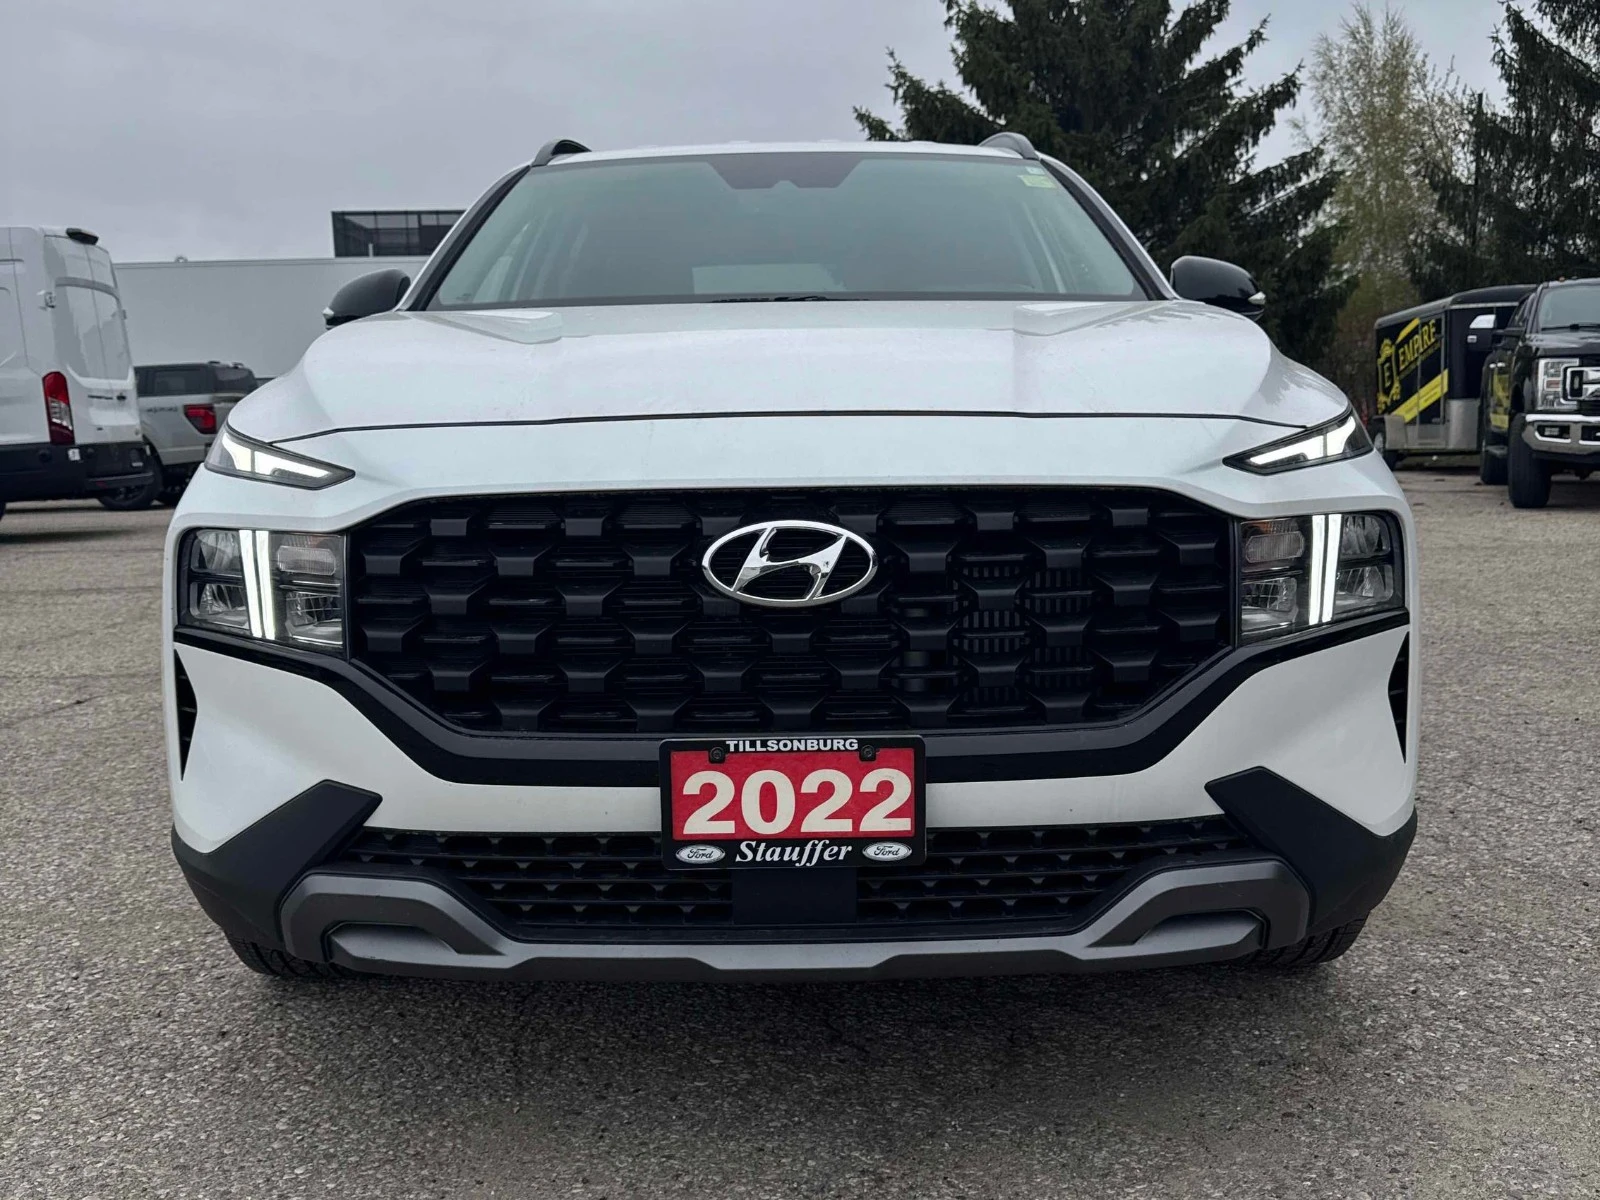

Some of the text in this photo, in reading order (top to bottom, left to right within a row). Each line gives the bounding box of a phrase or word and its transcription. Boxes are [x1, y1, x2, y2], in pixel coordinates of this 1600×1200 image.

[1398, 318, 1437, 372] EMPIRE
[726, 739, 859, 752] TILLSONBURG
[682, 768, 912, 835] 2022
[686, 847, 714, 860] Ford
[735, 840, 853, 867] Stauffer
[873, 844, 900, 857] Ford
